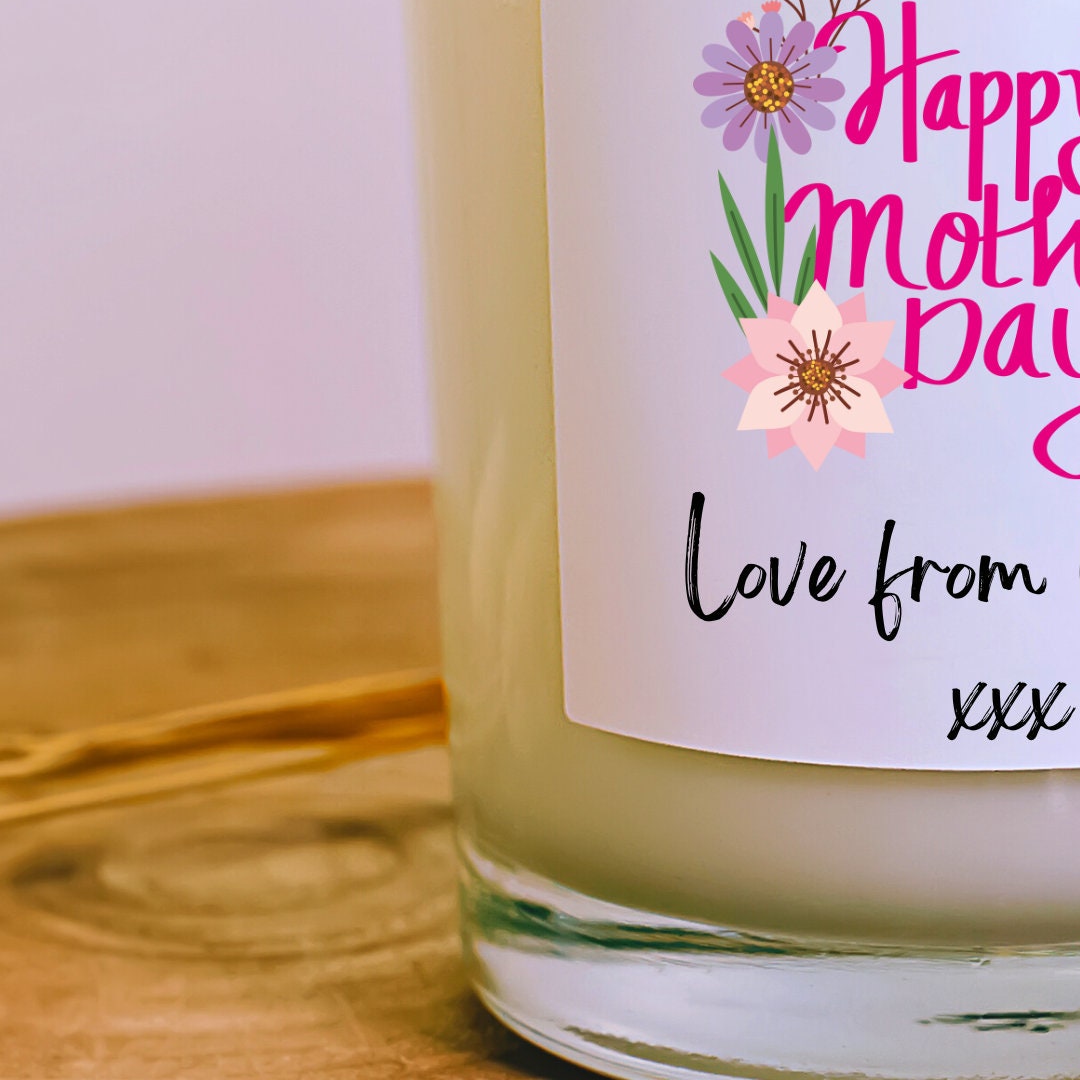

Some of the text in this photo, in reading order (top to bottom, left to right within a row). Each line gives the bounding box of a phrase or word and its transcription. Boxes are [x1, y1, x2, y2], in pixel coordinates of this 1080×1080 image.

[685, 492, 846, 621] Love
[868, 520, 1046, 641] from
[947, 682, 1075, 740] xxx
